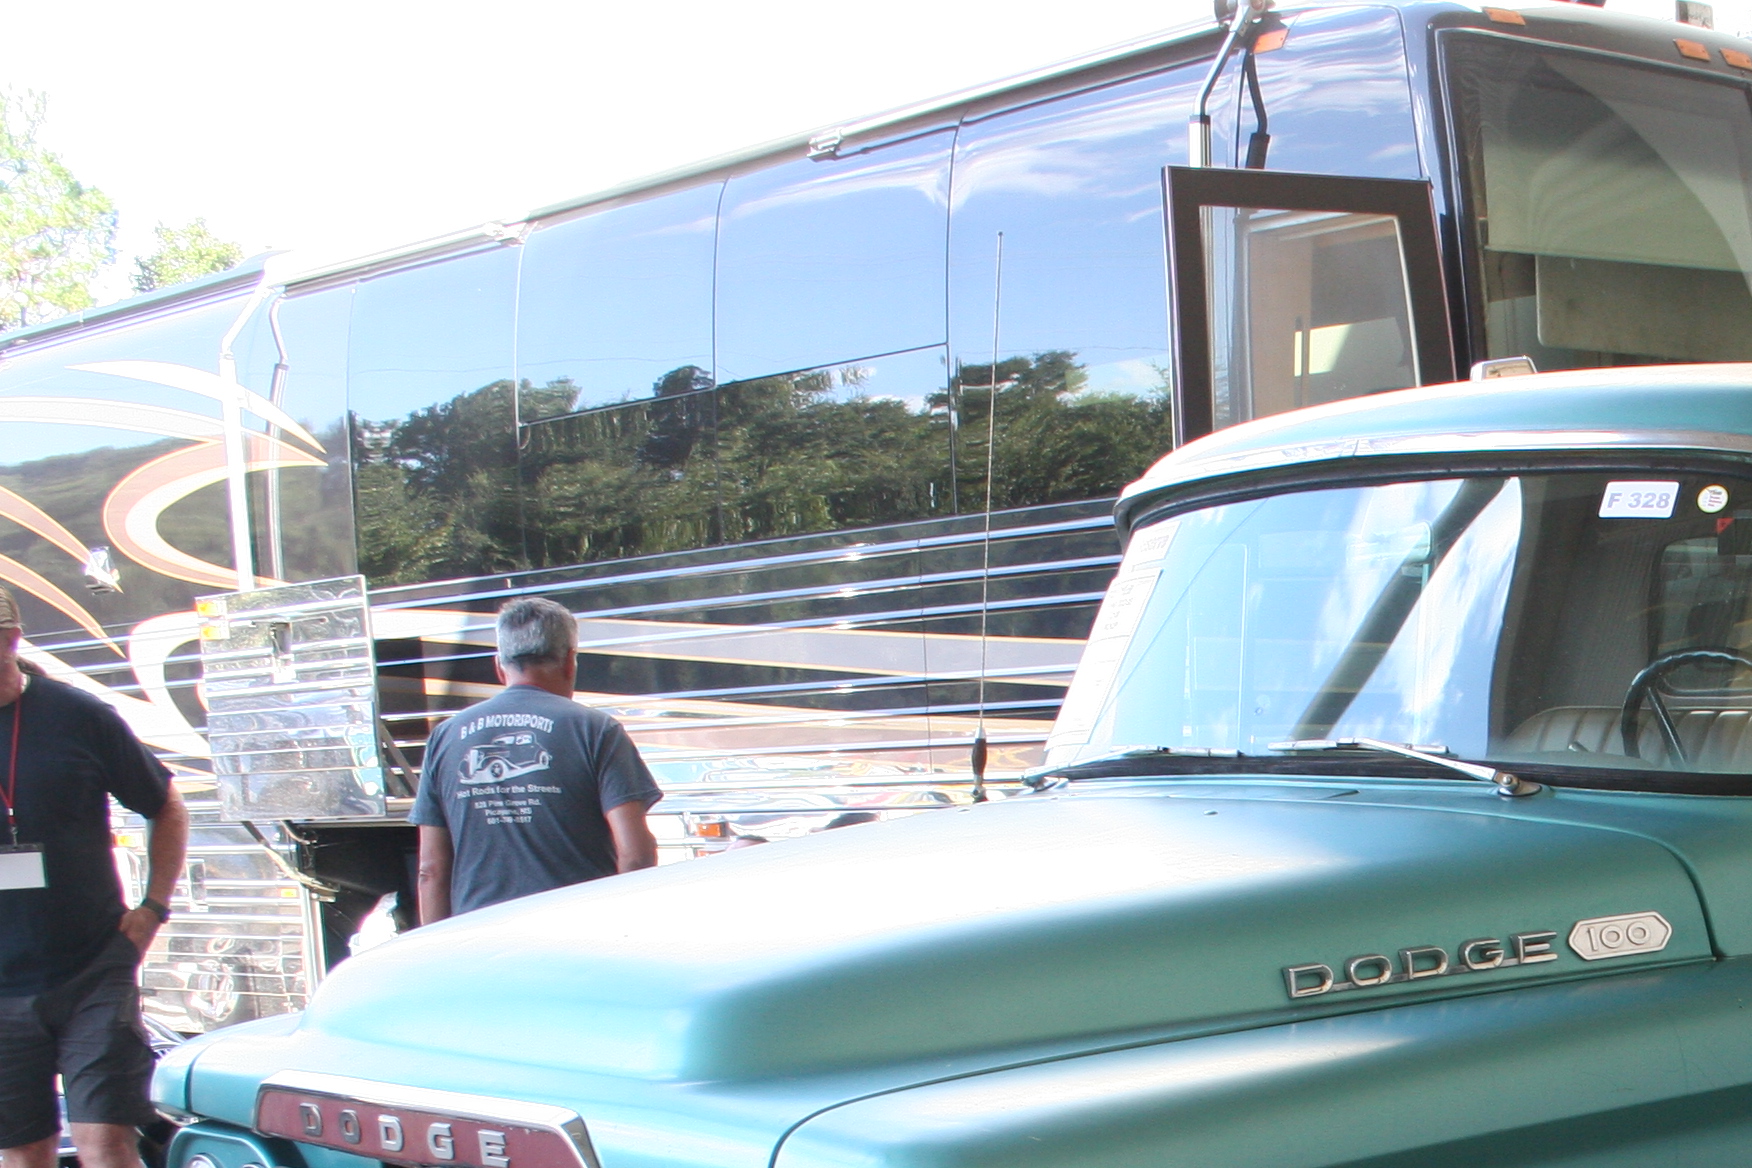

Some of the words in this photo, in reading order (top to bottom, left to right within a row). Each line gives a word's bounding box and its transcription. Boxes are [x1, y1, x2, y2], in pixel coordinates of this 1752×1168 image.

[1606, 492, 1623, 509] F
[1627, 492, 1671, 509] 328
[461, 726, 468, 740] B
[468, 721, 476, 735] &
[476, 717, 485, 731] B
[485, 713, 555, 733] MOTORSPORTS
[471, 786, 495, 796] Rods
[496, 785, 510, 794] for
[511, 785, 526, 794] the
[527, 784, 562, 794] Streets
[1282, 931, 1559, 999] DODGE
[1585, 921, 1651, 953] 100
[299, 1102, 511, 1168] DODGE
